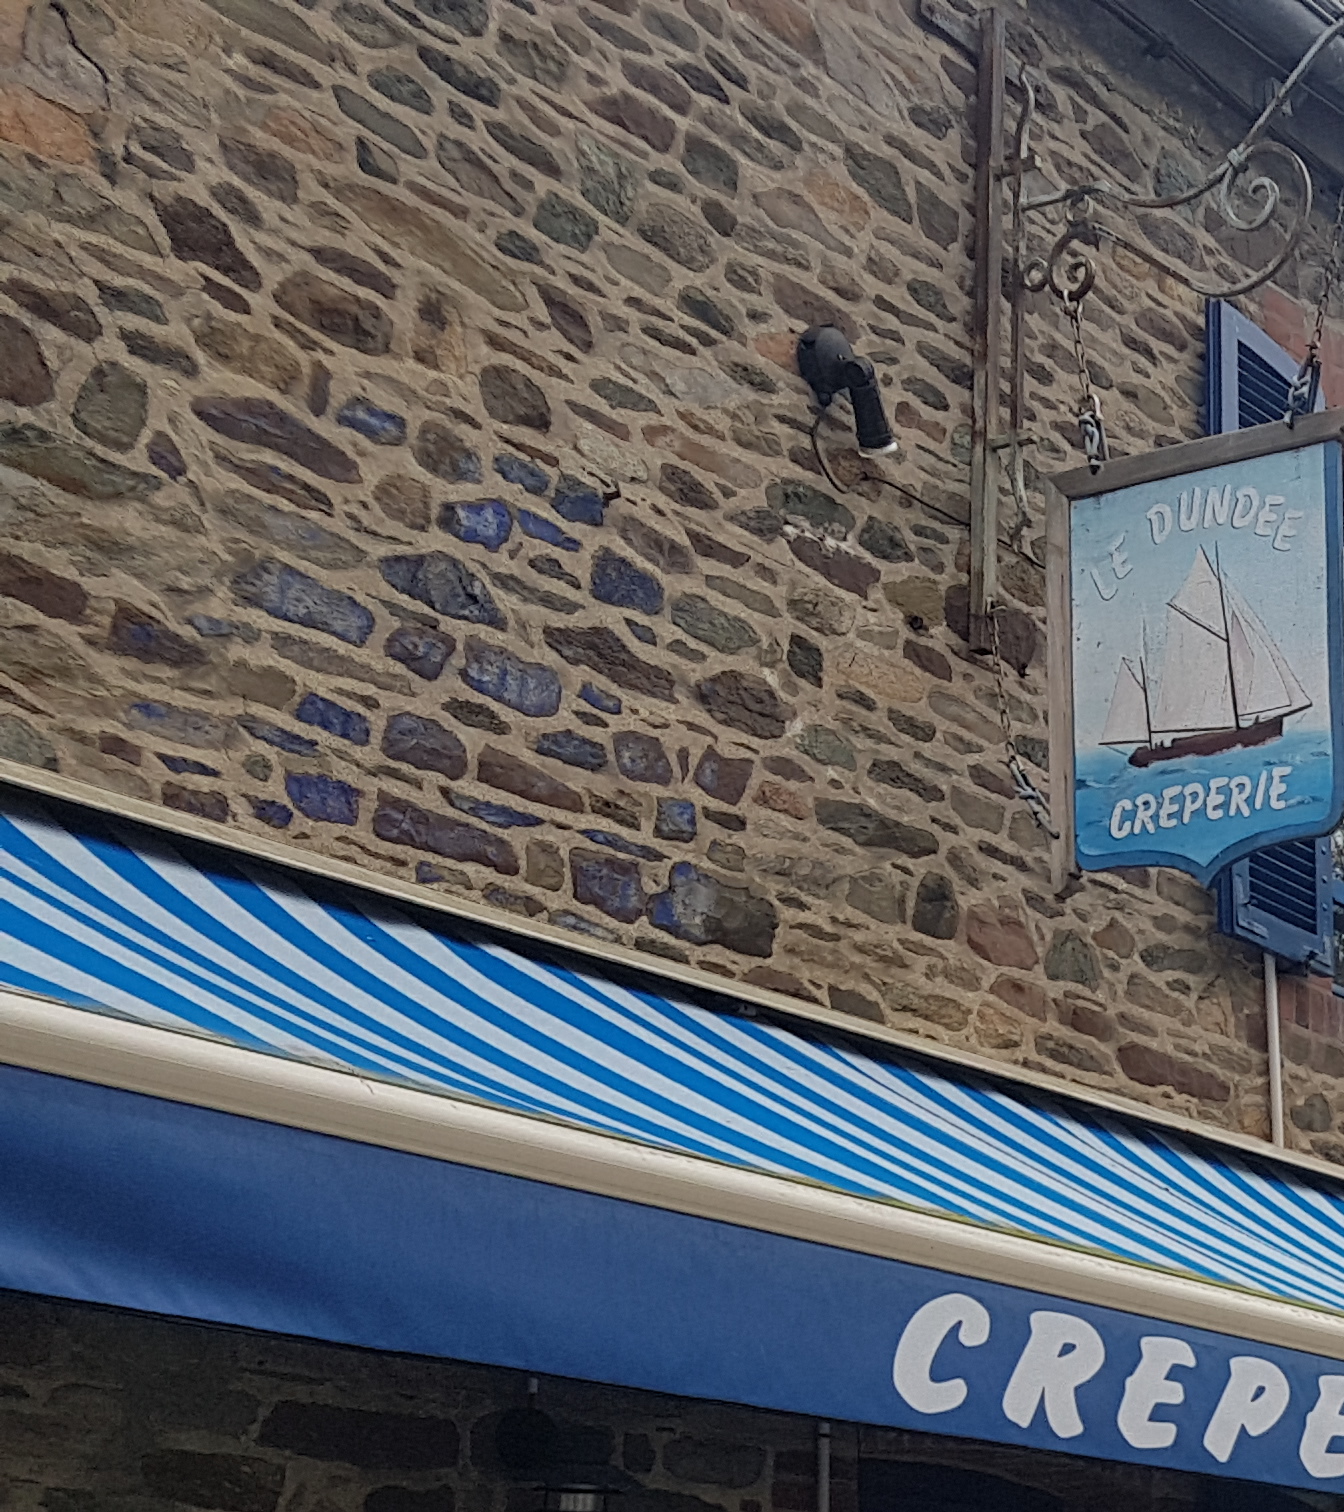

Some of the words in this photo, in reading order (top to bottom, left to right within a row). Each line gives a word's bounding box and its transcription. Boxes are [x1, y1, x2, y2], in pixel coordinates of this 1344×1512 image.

[1089, 531, 1134, 602] LE
[1145, 484, 1304, 552] DUNDEE
[1110, 766, 1293, 840] CREPERIE
